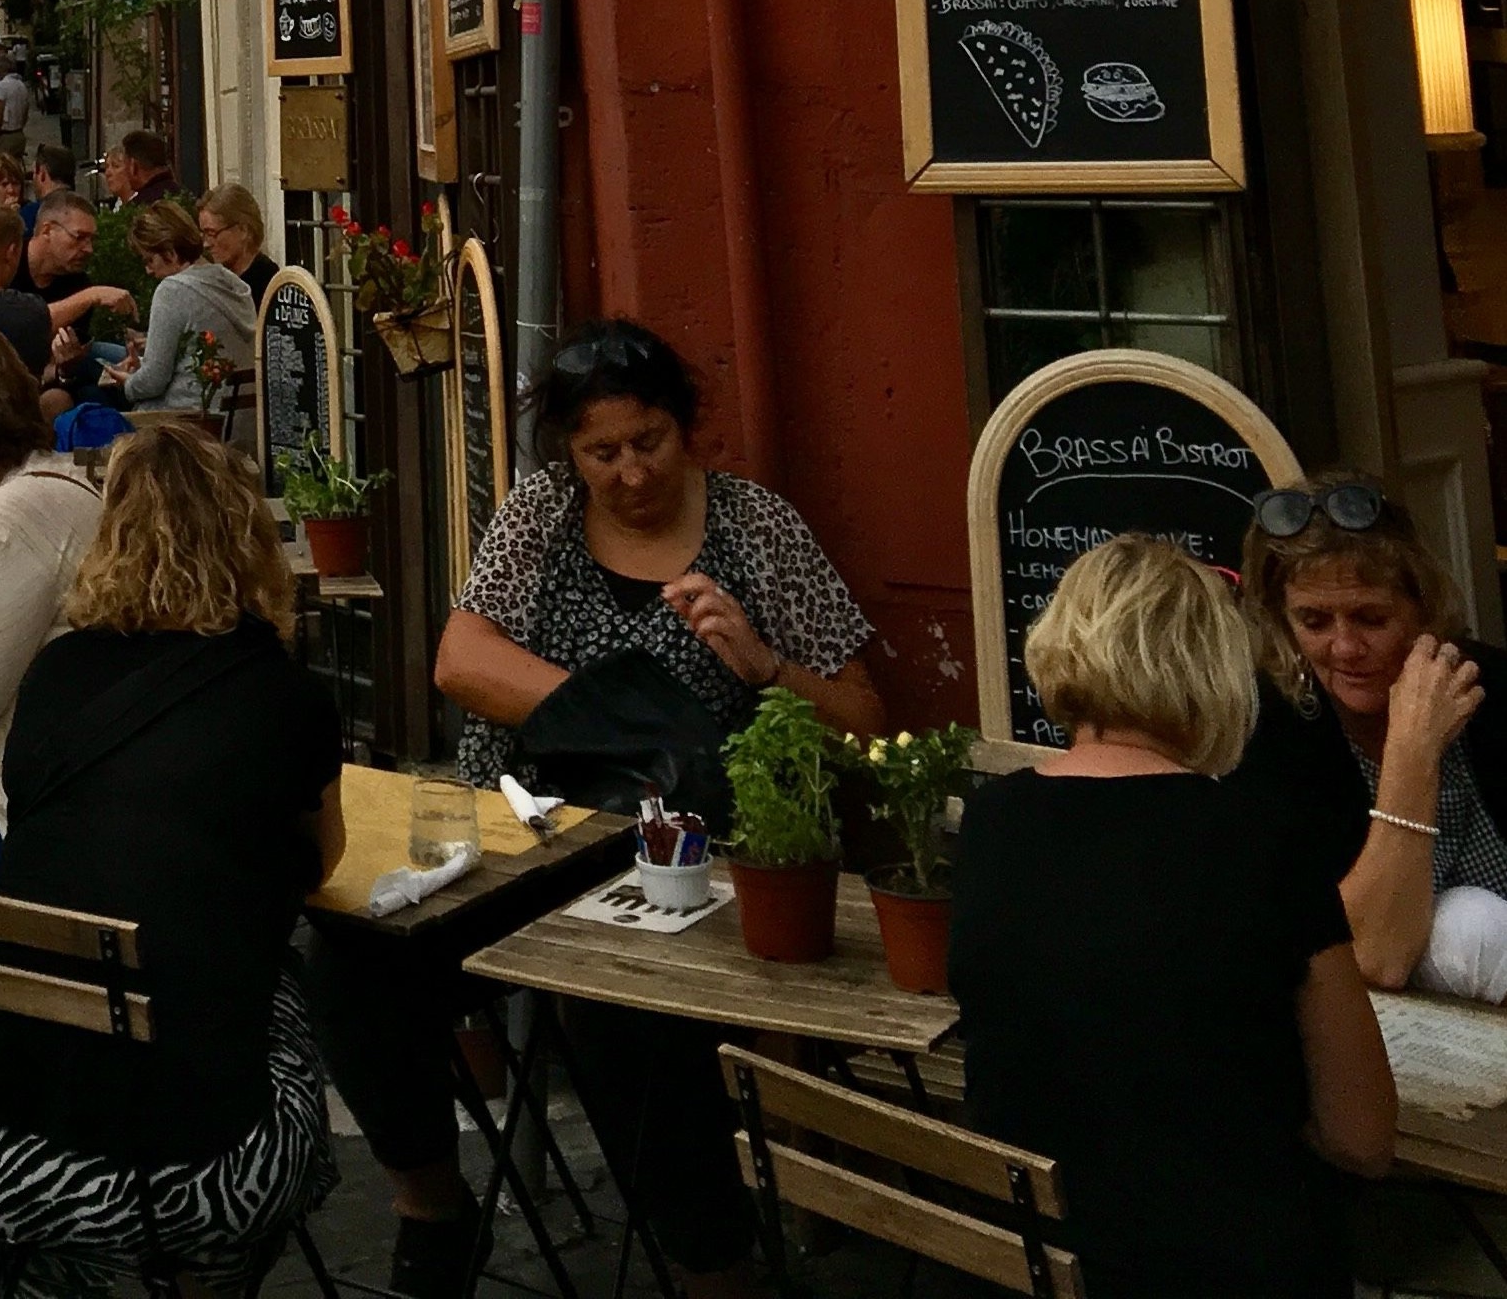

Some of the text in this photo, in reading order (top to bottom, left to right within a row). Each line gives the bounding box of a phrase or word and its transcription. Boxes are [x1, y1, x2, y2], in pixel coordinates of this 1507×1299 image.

[1019, 424, 1253, 478] BRASSAI BISTROT
[1019, 562, 1067, 580] LEMO
